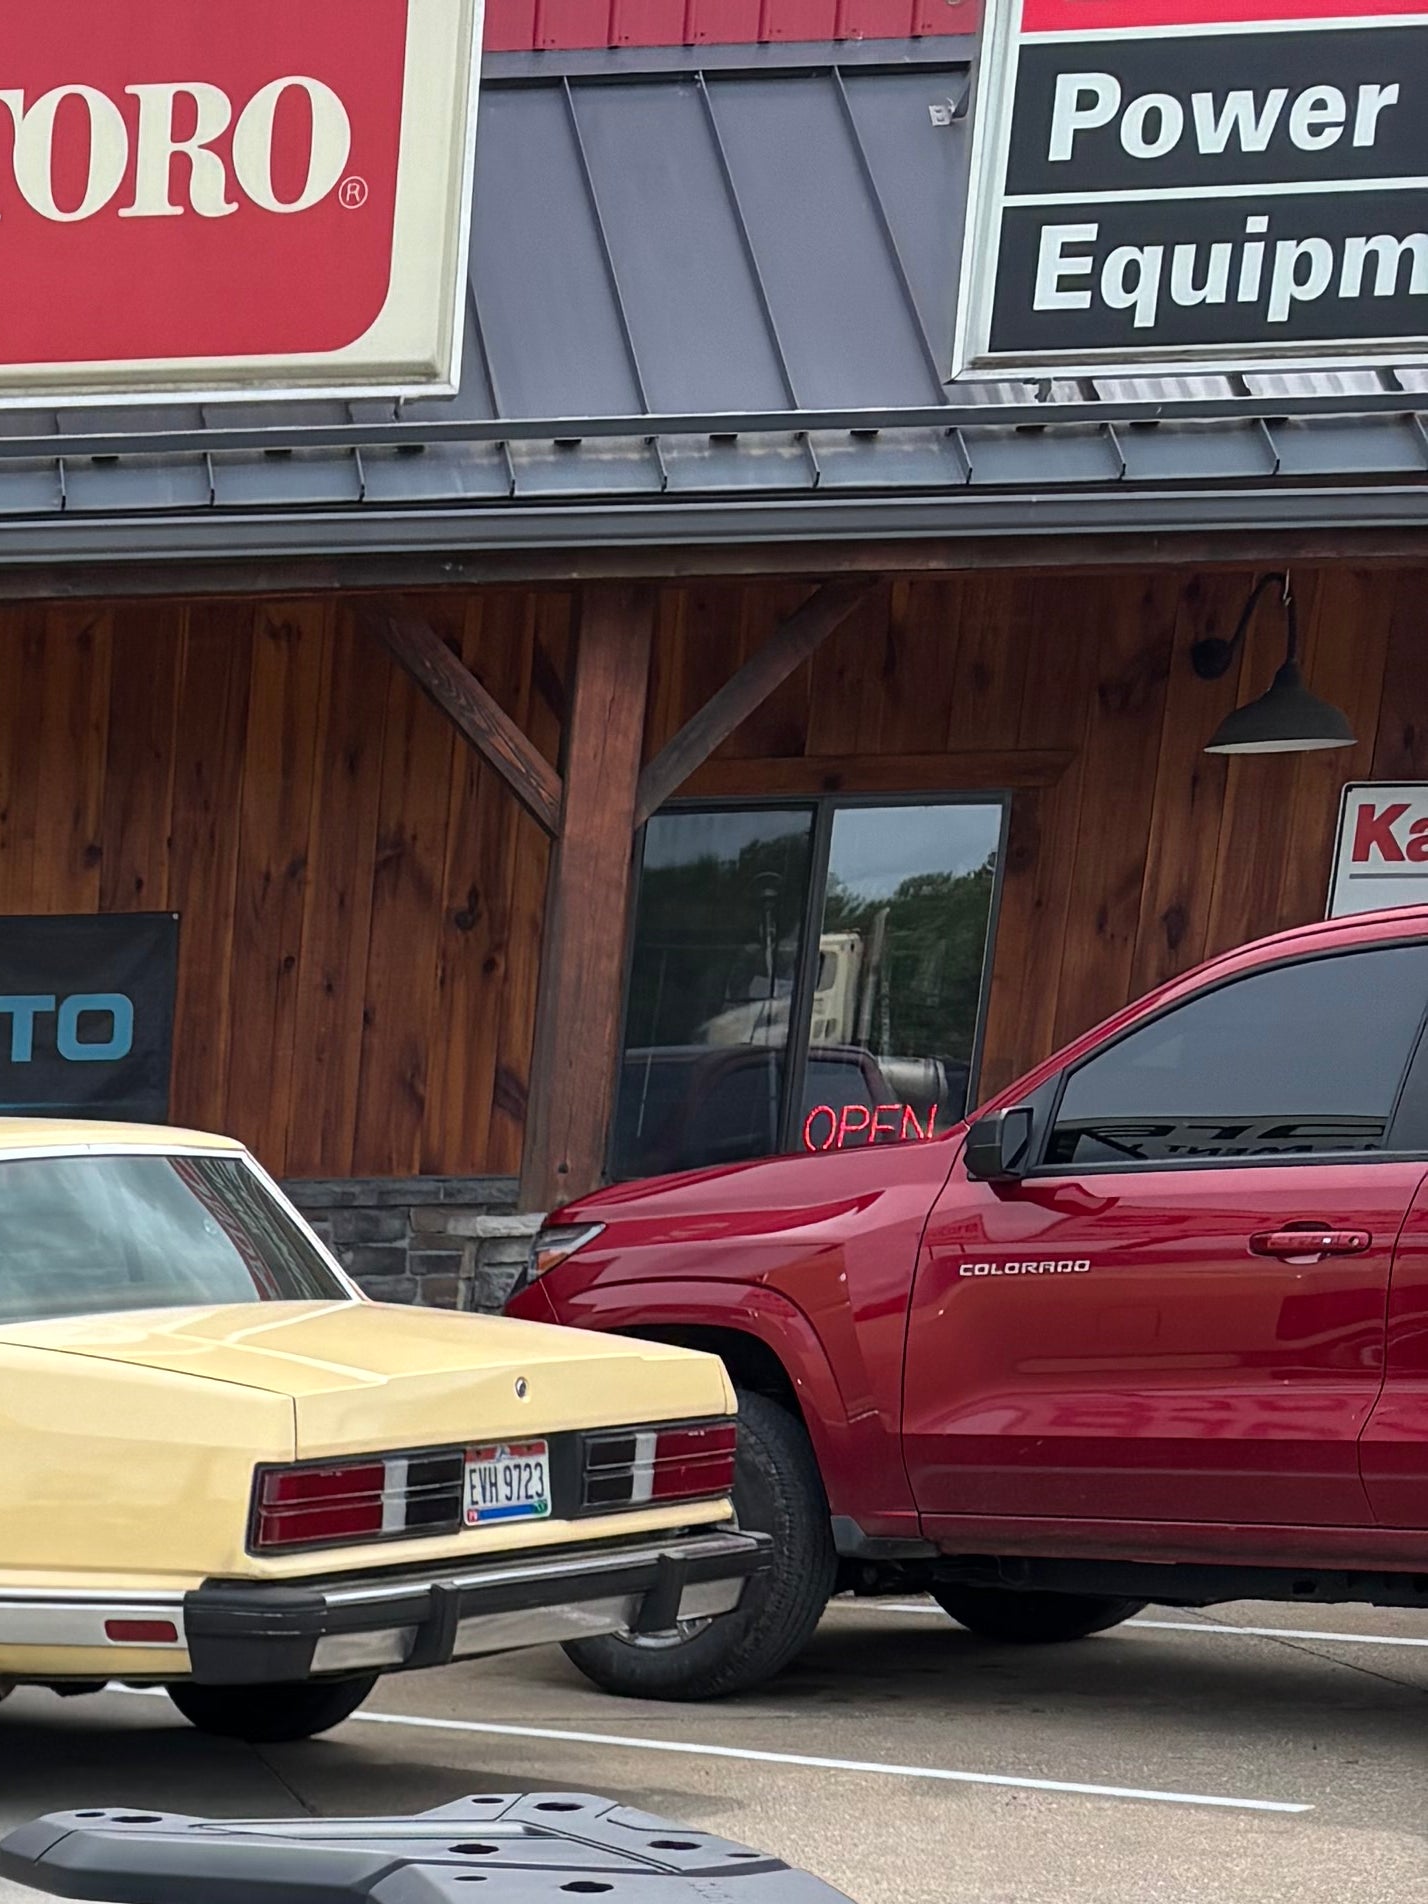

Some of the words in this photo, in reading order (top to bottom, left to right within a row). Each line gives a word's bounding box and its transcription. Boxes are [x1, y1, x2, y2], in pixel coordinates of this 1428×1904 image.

[1047, 71, 1400, 162] Power
[1032, 215, 1428, 328] Equipm
[959, 1259, 1091, 1277] COLORADO
[469, 1464, 499, 1506] EVH
[503, 1461, 545, 1502] 9723
